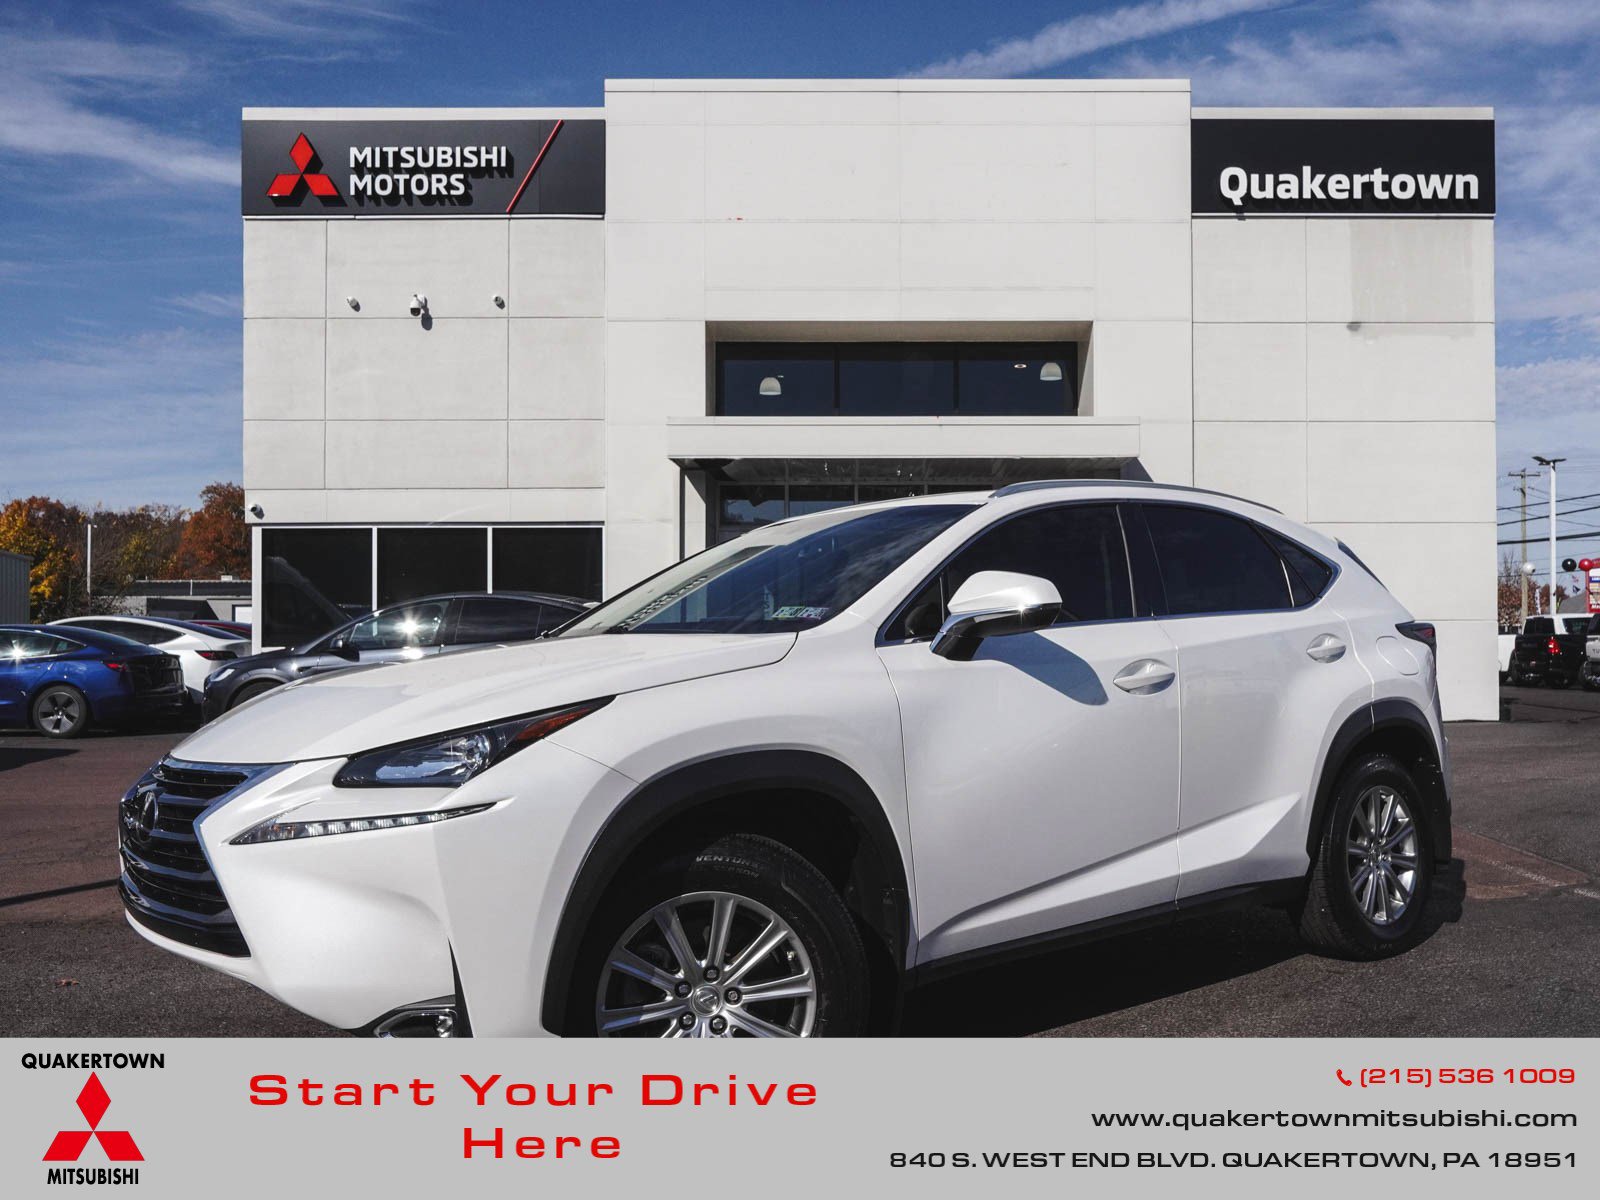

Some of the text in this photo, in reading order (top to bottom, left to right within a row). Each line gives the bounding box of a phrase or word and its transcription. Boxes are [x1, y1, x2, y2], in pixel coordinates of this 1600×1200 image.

[349, 146, 507, 168] MITSUBISHI
[349, 174, 465, 196] MOTORS
[1219, 165, 1479, 206] Quakertown
